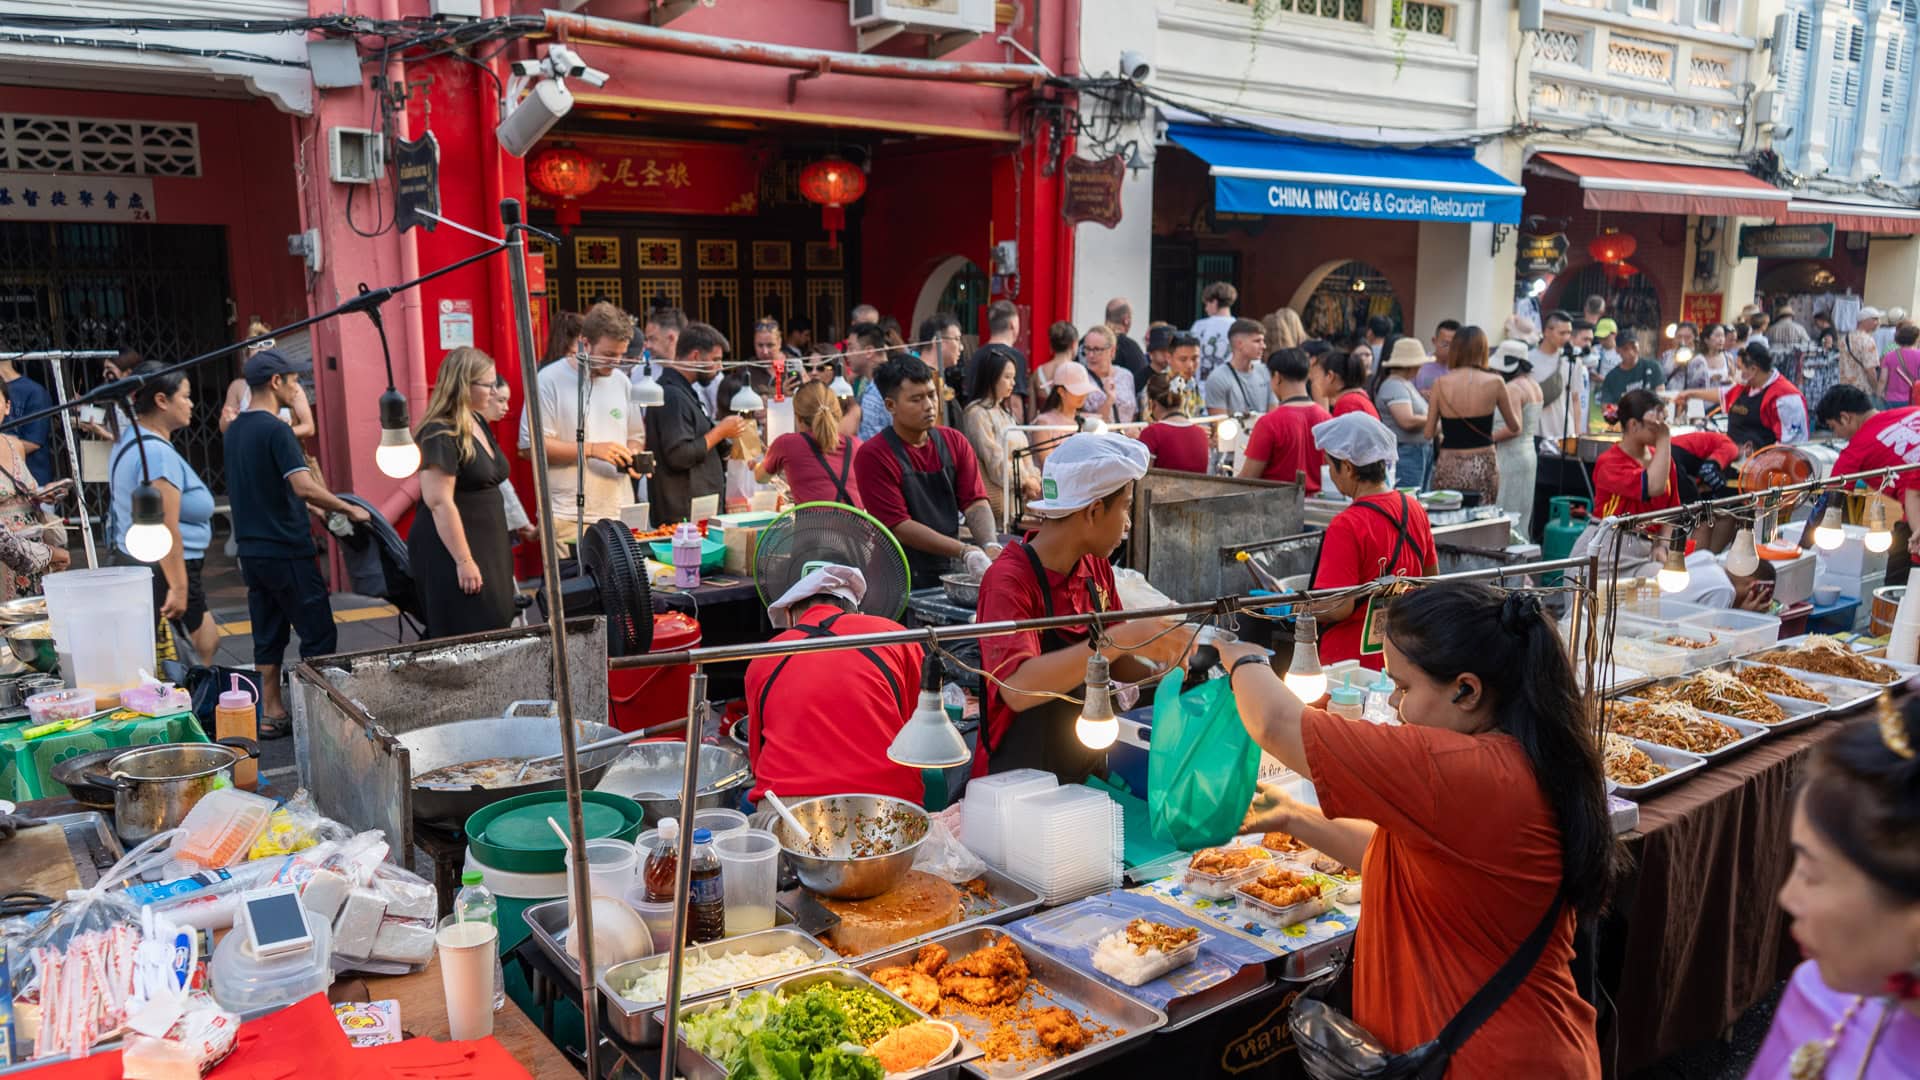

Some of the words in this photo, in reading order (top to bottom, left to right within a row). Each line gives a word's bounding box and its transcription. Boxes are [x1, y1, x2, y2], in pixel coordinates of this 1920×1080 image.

[1268, 186, 1311, 208] CHINA
[1314, 188, 1338, 210] INN
[1340, 190, 1370, 212] Café
[1373, 192, 1382, 212] &
[1384, 192, 1429, 214] Garden
[1430, 196, 1485, 217] Restaurant
[134, 210, 150, 220] 24
